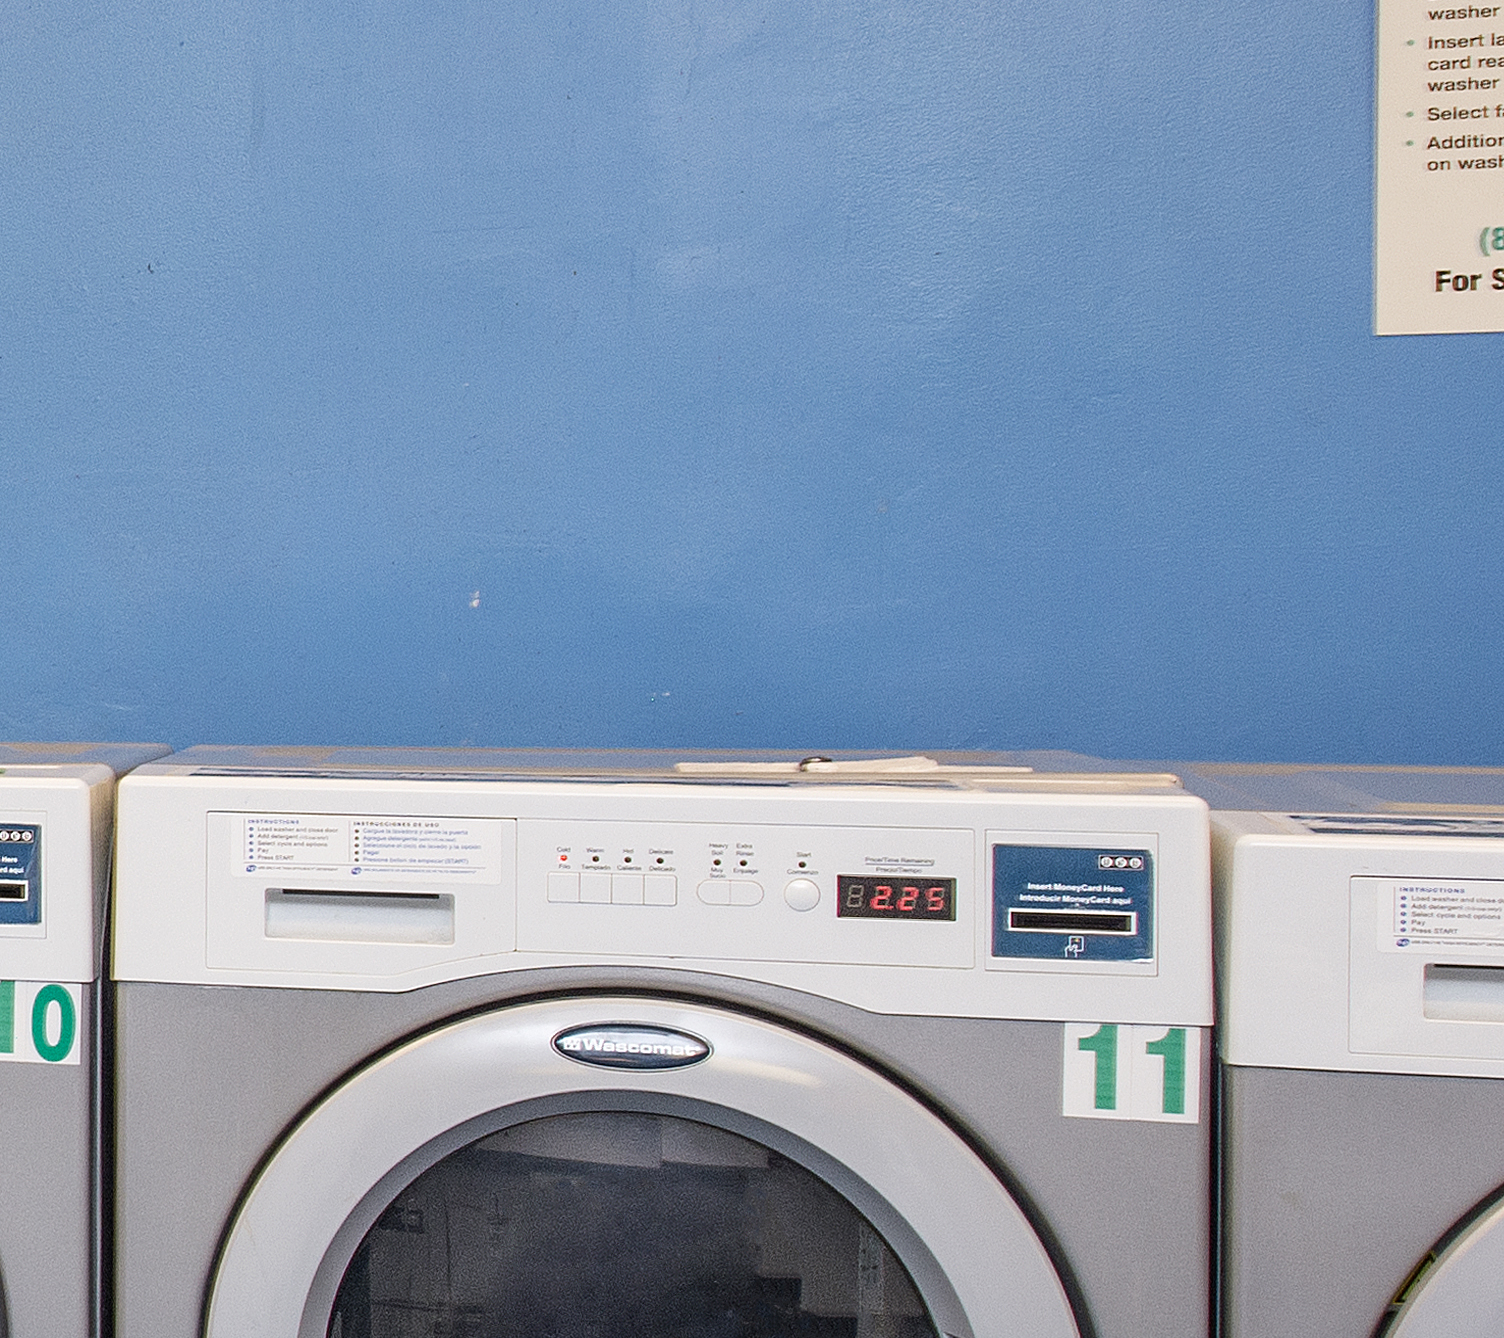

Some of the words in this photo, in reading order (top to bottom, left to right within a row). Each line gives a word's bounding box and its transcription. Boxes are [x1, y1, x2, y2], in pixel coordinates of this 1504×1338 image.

[1428, 5, 1500, 21] washer
[1428, 34, 1484, 50] Insert
[1428, 55, 1471, 71] card
[1427, 77, 1500, 92] washer
[1427, 105, 1489, 121] Select
[1427, 159, 1451, 171] on
[1434, 270, 1482, 293] For
[0, 855, 18, 864] Here
[1028, 882, 1052, 892] Insert
[1054, 883, 1102, 894] MoneyCard
[1103, 884, 1124, 893] Here
[1019, 894, 1061, 904] Introducir
[1062, 895, 1111, 907] MoneyCard
[1078, 1024, 1186, 1114] 11
